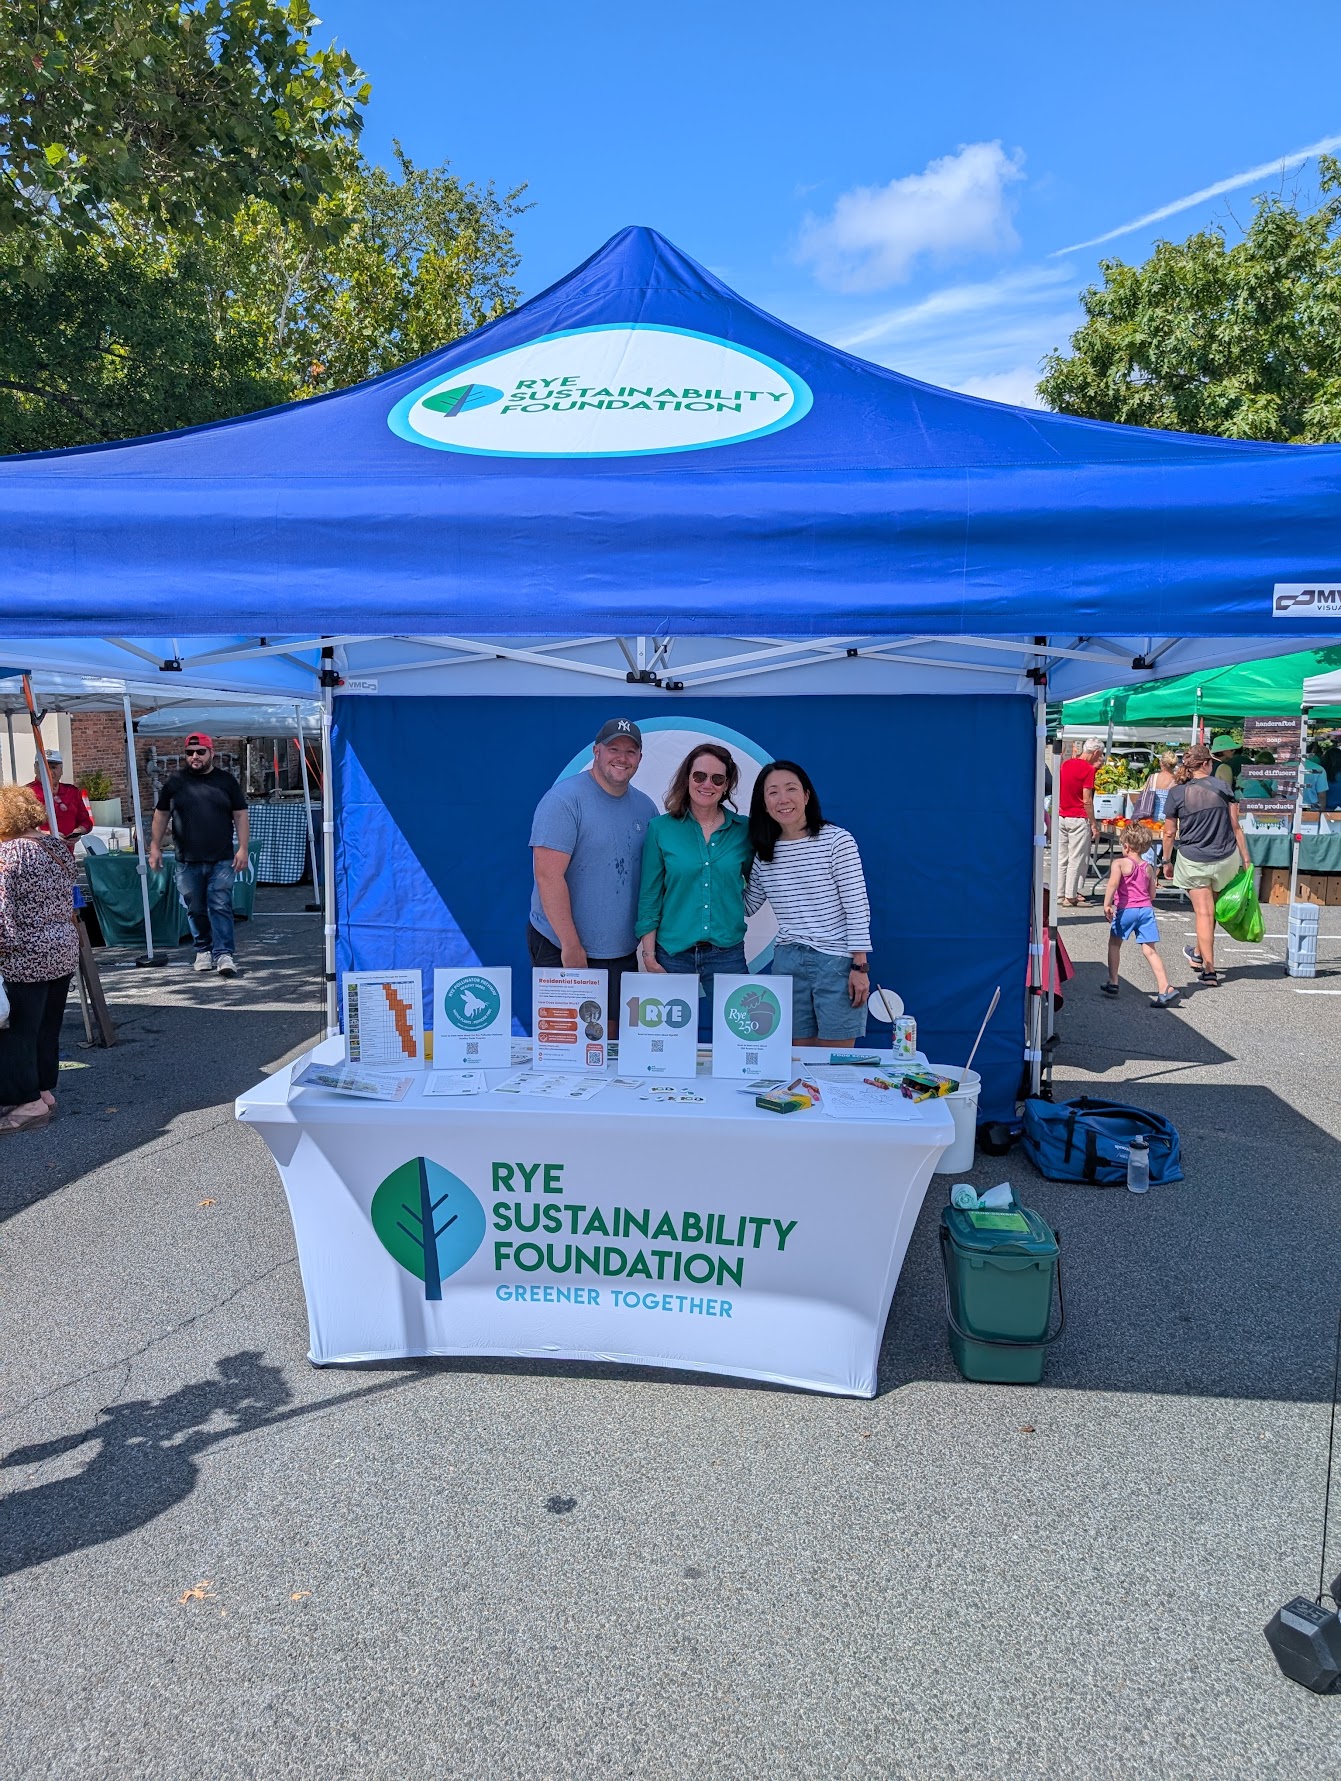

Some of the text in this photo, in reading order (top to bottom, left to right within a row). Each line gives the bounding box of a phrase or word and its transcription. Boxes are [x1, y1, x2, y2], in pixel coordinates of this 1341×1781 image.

[515, 376, 580, 390] RYE
[508, 387, 789, 402] SUSTAINABILITY
[500, 400, 742, 414] FOUNDATION
[618, 719, 631, 732] NY
[538, 977, 573, 985] Residential
[645, 1005, 682, 1022] RYE
[728, 1008, 747, 1023] Rye
[738, 1020, 759, 1034] 250
[491, 1161, 565, 1194] RYE
[492, 1201, 798, 1251] SUSTAINABILITY
[494, 1241, 745, 1288] FOUNDATION
[495, 1284, 733, 1319] GREENER TOGETHER
